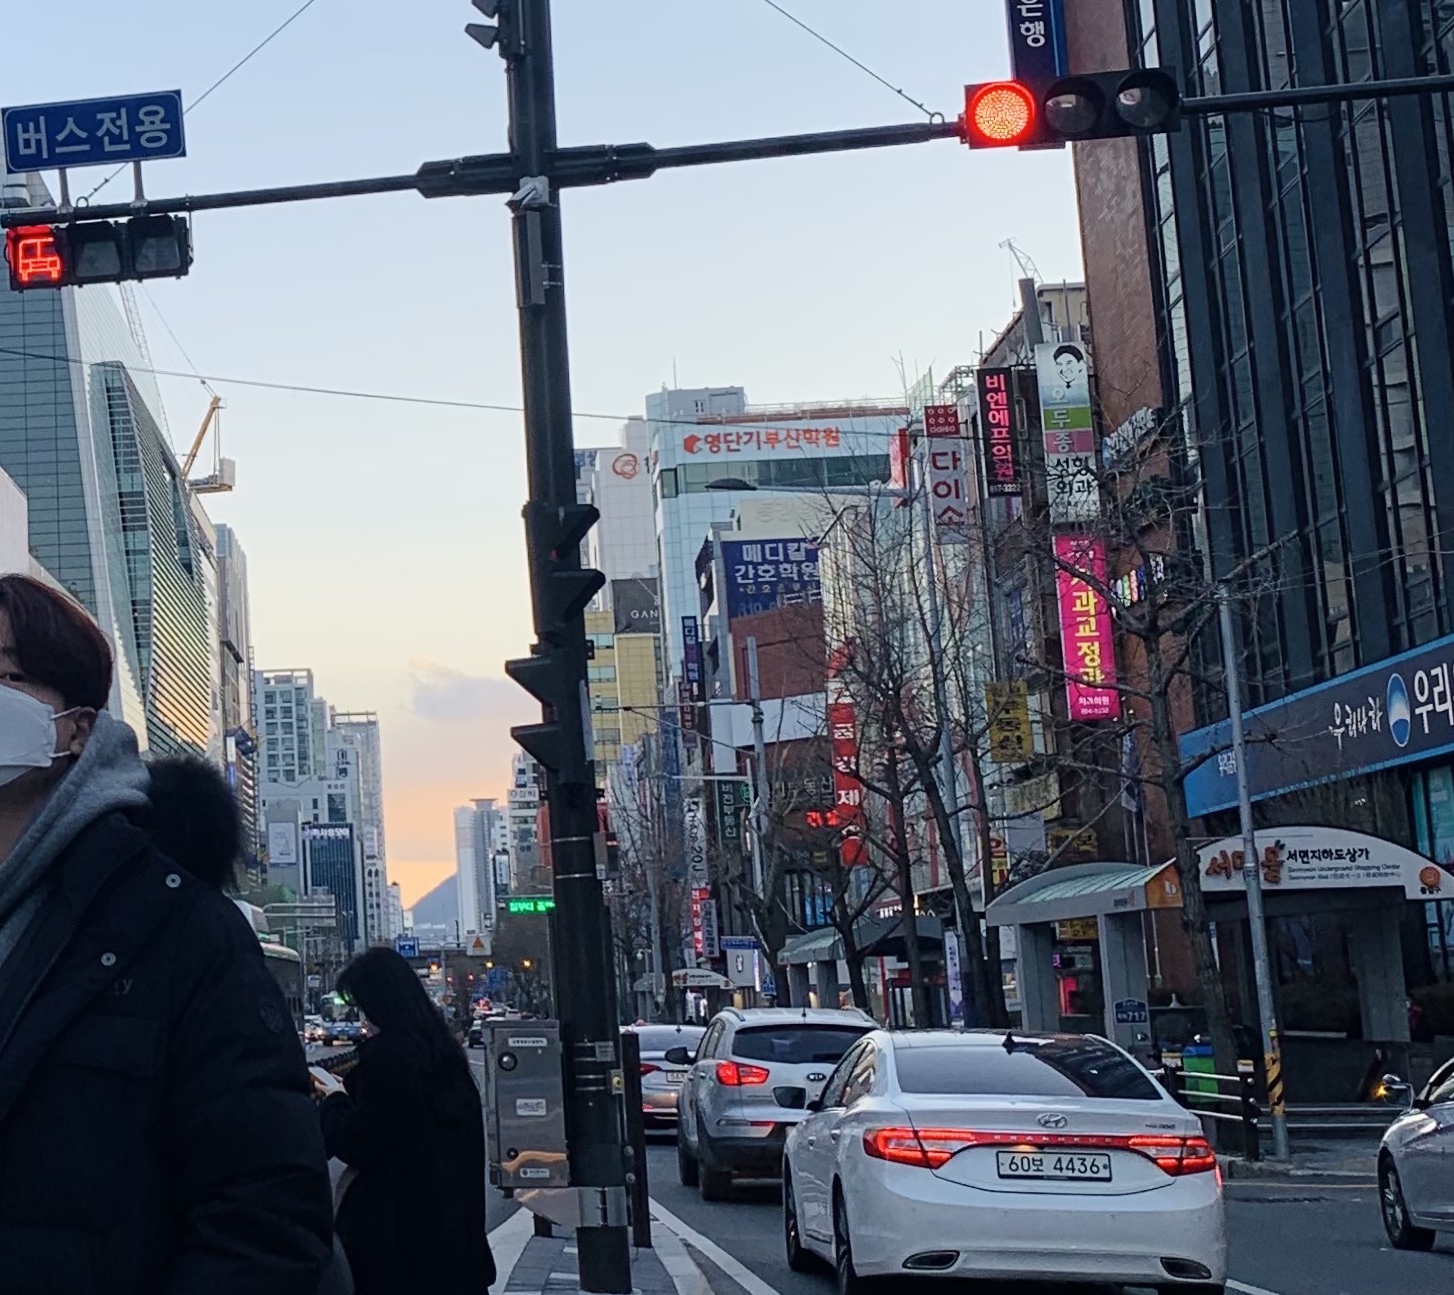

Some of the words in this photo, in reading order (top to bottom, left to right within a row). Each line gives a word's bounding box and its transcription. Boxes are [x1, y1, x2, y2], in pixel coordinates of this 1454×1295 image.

[16, 105, 172, 161] 버스전용
[704, 426, 840, 454] 영단기부산학원
[986, 374, 1014, 481] 비엔에프의원
[931, 451, 965, 526] 다이소
[742, 543, 806, 562] 메디칼
[735, 562, 821, 584] 간호학원
[1325, 697, 1383, 751] 우리나라
[1413, 662, 1454, 735] 우리
[1287, 848, 1370, 864] 서면지하도상가
[1008, 1156, 1044, 1173] 60보
[1053, 1156, 1101, 1175] 4436
